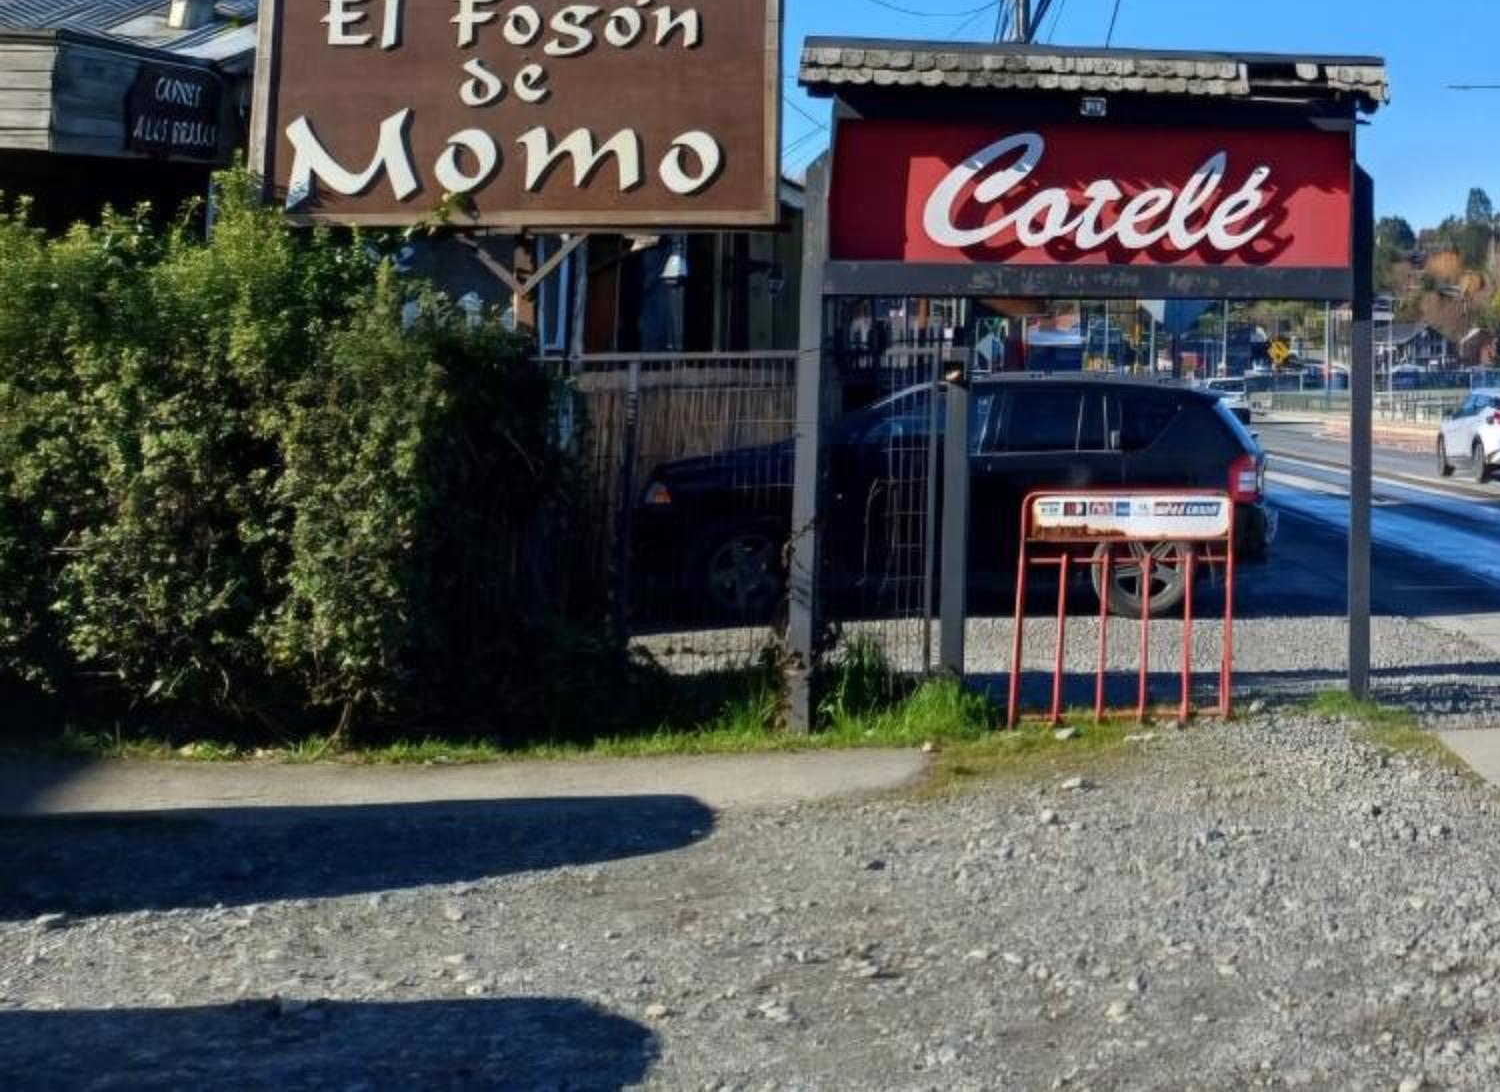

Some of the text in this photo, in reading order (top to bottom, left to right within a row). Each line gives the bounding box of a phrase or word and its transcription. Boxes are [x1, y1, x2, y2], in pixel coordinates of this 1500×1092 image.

[459, 57, 551, 104] de
[285, 108, 722, 210] Momo
[922, 131, 1271, 251] Cotelé
